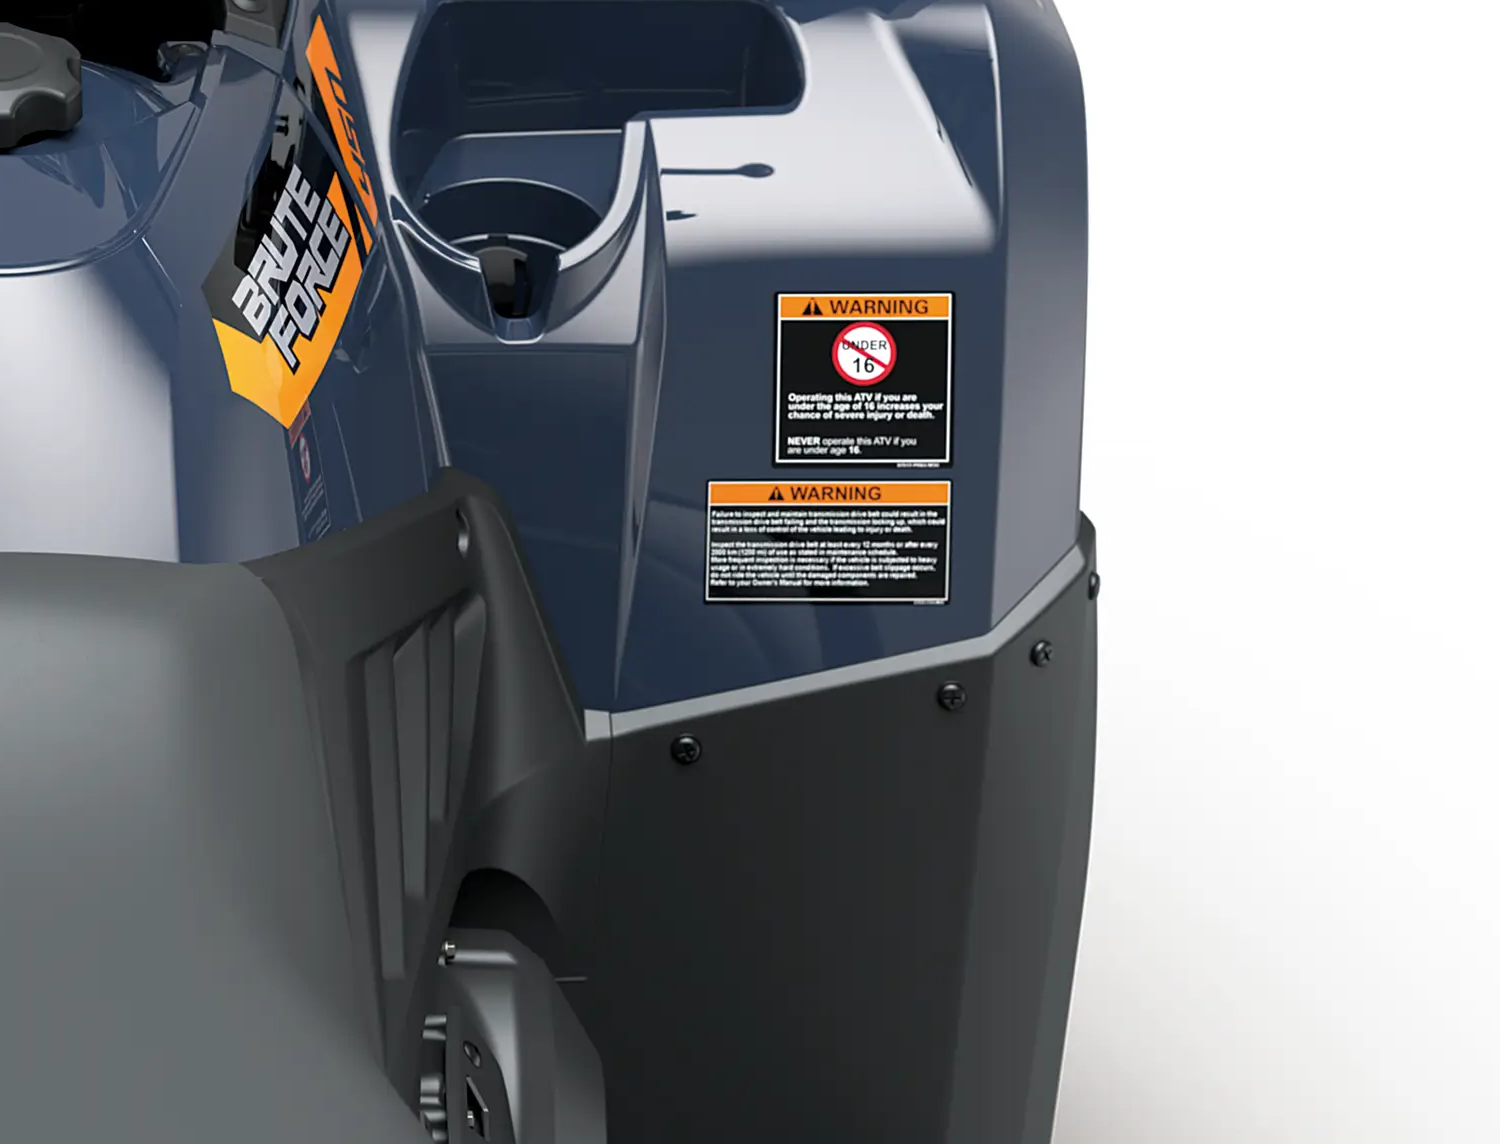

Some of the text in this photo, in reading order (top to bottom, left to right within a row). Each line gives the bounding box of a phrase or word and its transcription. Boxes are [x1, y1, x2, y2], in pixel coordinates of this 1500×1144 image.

[232, 163, 321, 337] BRUTE
[268, 196, 350, 374] FORCE
[830, 299, 928, 314] WARNING
[842, 340, 887, 350] UNDER
[853, 357, 875, 373] 16
[788, 393, 833, 403] Operating
[835, 393, 852, 401] this
[854, 393, 872, 401] ATV
[874, 393, 881, 401] if
[883, 394, 900, 403] you
[788, 402, 943, 412] under the age of 16 increases your
[788, 411, 821, 419] chance
[823, 411, 832, 419] of
[866, 411, 892, 421] injury
[788, 436, 916, 447] NEVER operate this ATV if you
[804, 446, 828, 454] under
[830, 447, 846, 456] age
[791, 486, 882, 501] WARNING
